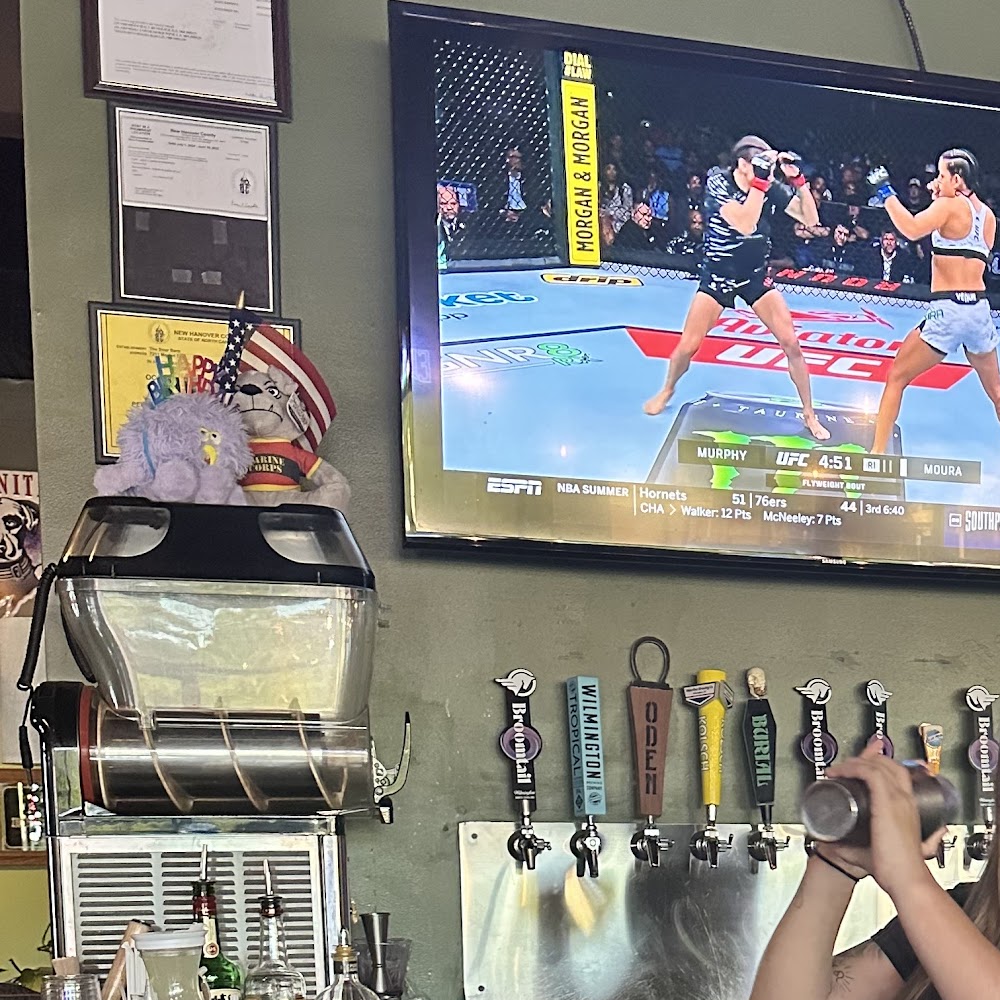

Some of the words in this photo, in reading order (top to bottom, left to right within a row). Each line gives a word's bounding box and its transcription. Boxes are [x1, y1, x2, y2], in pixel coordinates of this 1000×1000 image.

[563, 51, 591, 67] DIAL
[570, 96, 591, 166] MORGAN
[574, 171, 591, 182] &
[574, 187, 594, 252] MORGAN
[173, 329, 188, 337] NEW
[715, 344, 883, 378] UFC
[253, 456, 285, 466] ARINE
[697, 447, 748, 461] MURPHY
[776, 451, 811, 467] UFC
[818, 455, 853, 470] 4:51
[923, 463, 963, 477] MOURA
[486, 476, 543, 496] ESPN
[557, 482, 580, 494] NBA
[582, 483, 629, 497] SUMMER
[802, 479, 844, 489] FLYWEIGHT
[639, 487, 688, 501] Hornets
[731, 493, 746, 505] 51
[754, 495, 788, 508] 76ers
[840, 501, 857, 514] 44
[640, 503, 665, 514] CHA
[680, 505, 720, 518] Walker:
[720, 508, 733, 519] 12
[734, 508, 752, 520] Pts
[865, 505, 882, 515] 3rd
[883, 505, 905, 516] 6:40
[763, 511, 816, 527] McNeeley:
[817, 514, 825, 525] 7
[825, 515, 842, 526] Pts
[569, 695, 581, 776] TROPICAL
[581, 684, 601, 779] WILMINGTON
[512, 702, 532, 784] Broomtail
[645, 701, 658, 795] ODEN
[698, 715, 710, 772] KOLSCH
[751, 714, 772, 788] BURIAL
[810, 709, 827, 780] Broomtai
[978, 716, 995, 793] Broomtail
